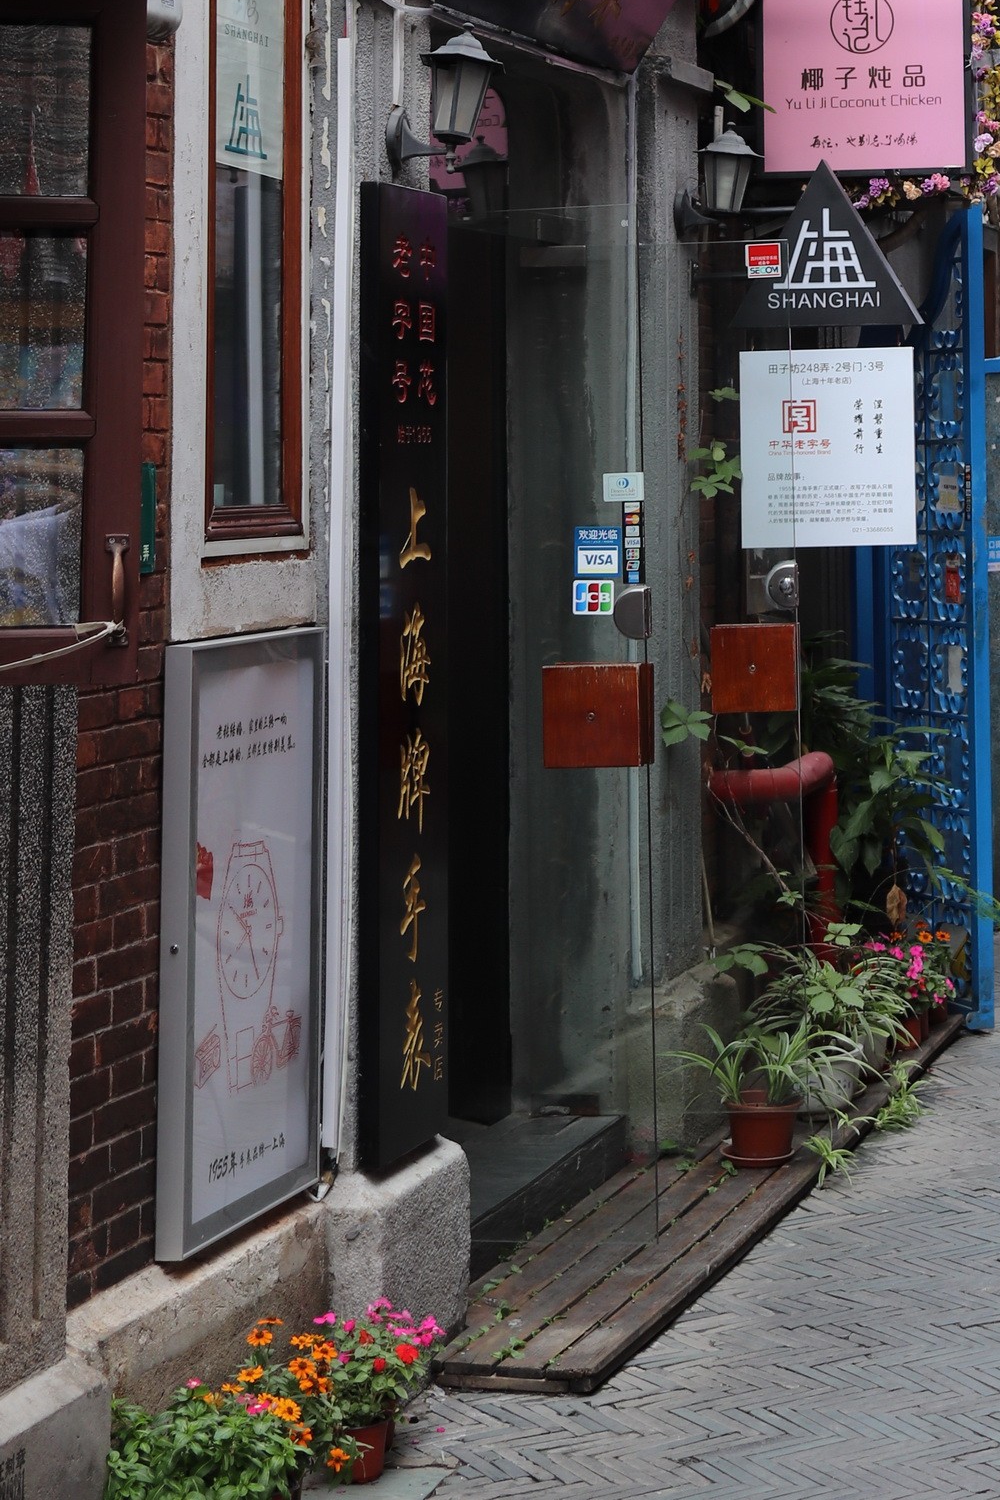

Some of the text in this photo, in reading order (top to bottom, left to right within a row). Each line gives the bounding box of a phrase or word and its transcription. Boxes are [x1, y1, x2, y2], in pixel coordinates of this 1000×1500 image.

[224, 23, 269, 47] SHANGHAI
[801, 64, 926, 91] 椰子炖品
[785, 93, 942, 110] Yu Li Ji Coconut Chicken
[750, 266, 778, 275] SECOM
[767, 290, 881, 309] SHANGHAI
[392, 234, 412, 404] 老字号
[768, 439, 831, 450] 中华老字号
[578, 529, 618, 541] 欢迎光临
[584, 554, 613, 566] VISA
[575, 592, 611, 604] JCB
